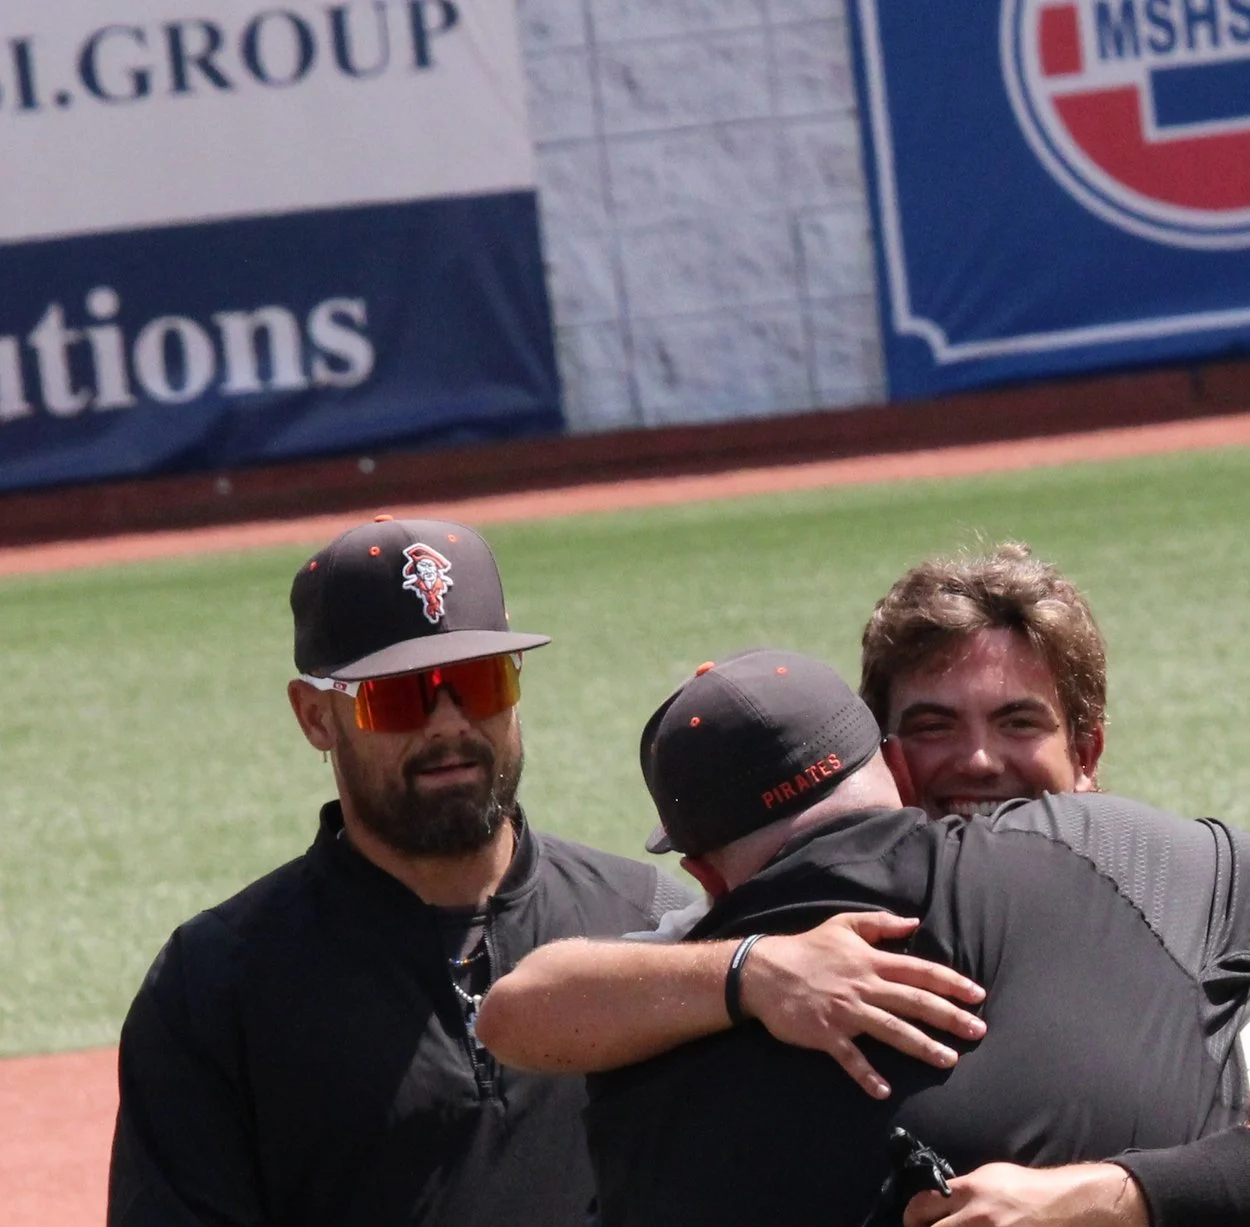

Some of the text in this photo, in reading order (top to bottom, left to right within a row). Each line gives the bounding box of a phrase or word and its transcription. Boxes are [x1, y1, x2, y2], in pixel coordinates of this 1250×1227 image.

[0, 0, 462, 115] I.GROUP
[0, 285, 375, 421] tions
[761, 753, 841, 809] PIRATES
